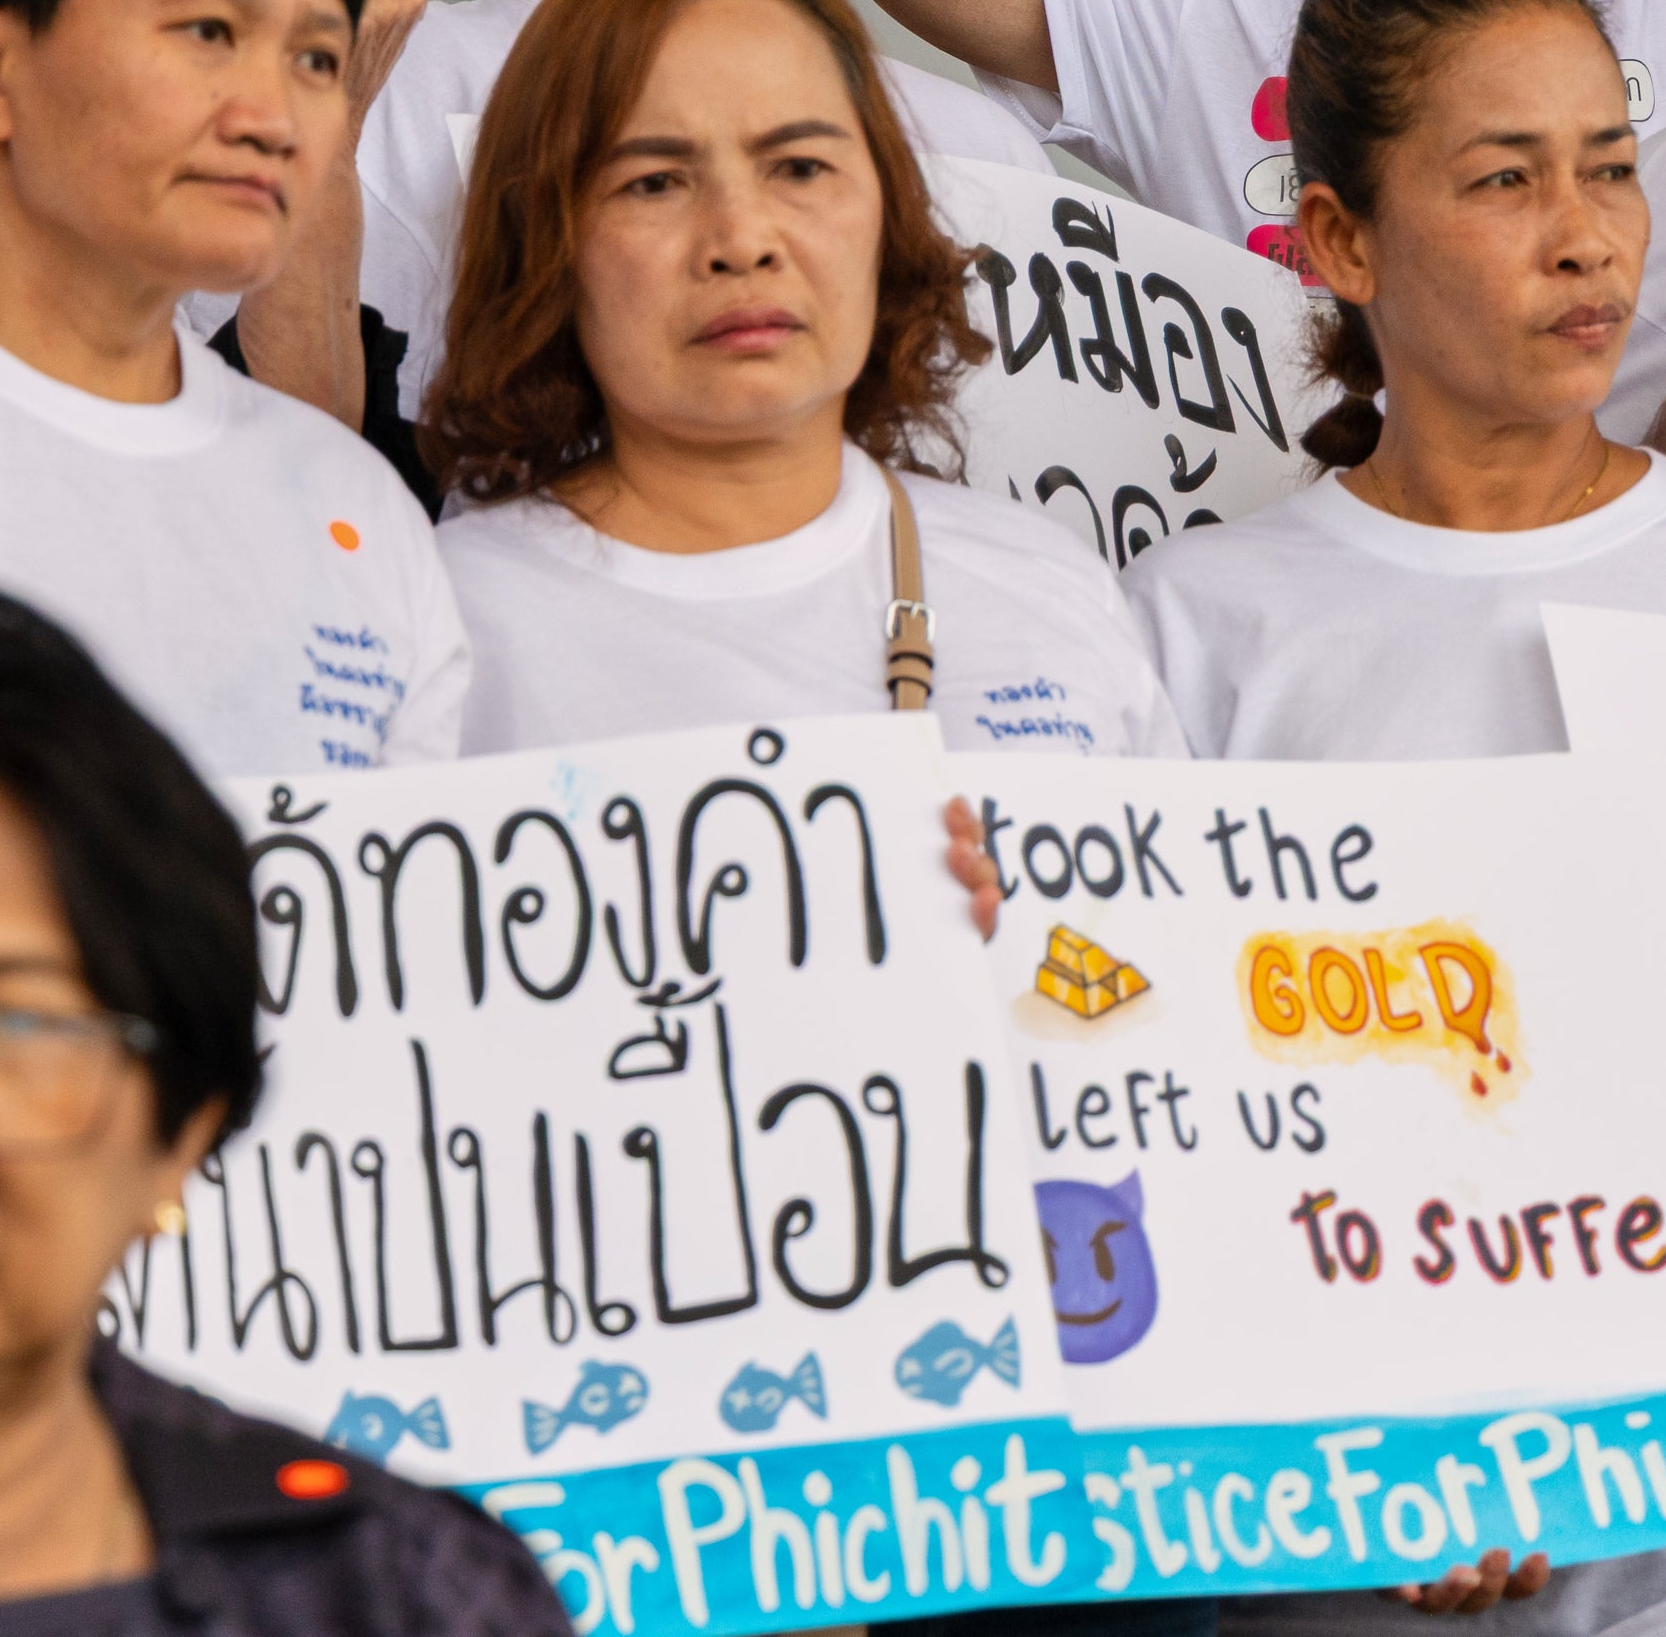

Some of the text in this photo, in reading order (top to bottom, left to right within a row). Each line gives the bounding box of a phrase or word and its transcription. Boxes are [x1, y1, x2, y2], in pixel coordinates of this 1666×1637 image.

[245, 727, 889, 1018] ด้ทองคำ
[1204, 806, 1379, 903] the
[1249, 939, 1494, 1053] GOLD
